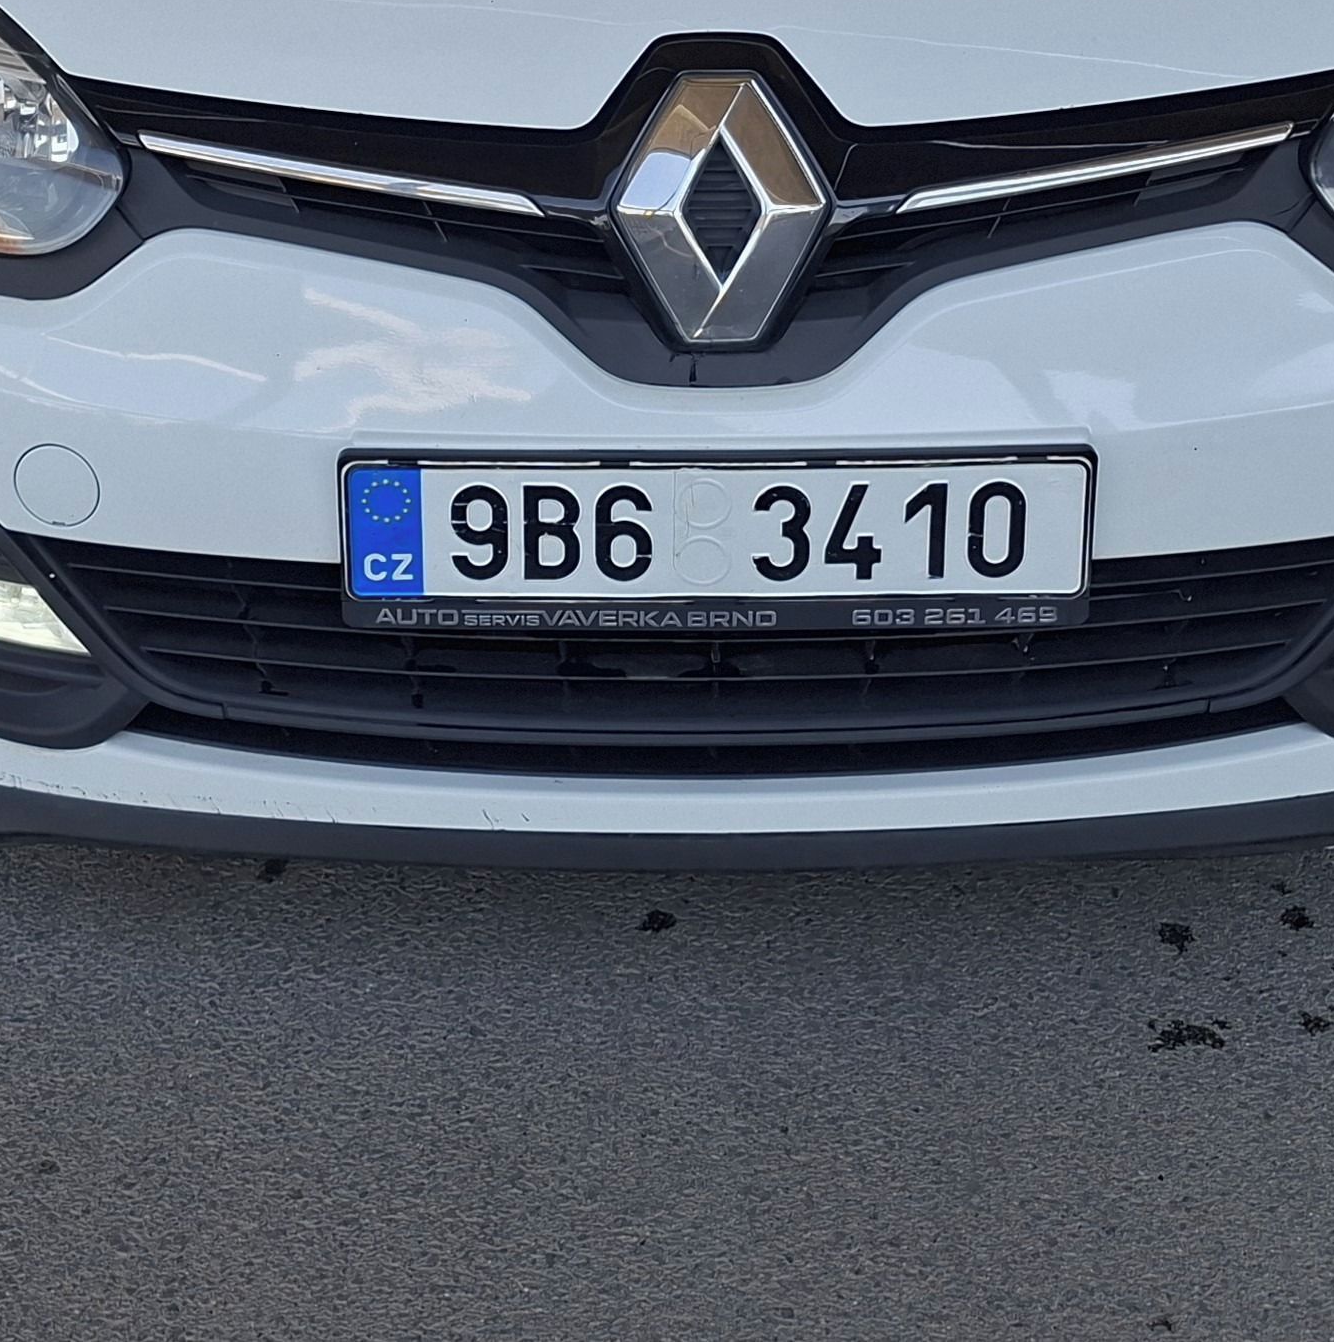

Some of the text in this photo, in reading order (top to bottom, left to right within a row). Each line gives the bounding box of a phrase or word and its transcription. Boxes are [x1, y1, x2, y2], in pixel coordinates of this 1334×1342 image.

[451, 481, 1027, 582] 9B6 3410
[363, 554, 414, 581] CZ
[687, 610, 777, 627] BRNO
[852, 609, 915, 625] 603
[924, 608, 986, 625] 261
[995, 607, 1058, 624] 469
